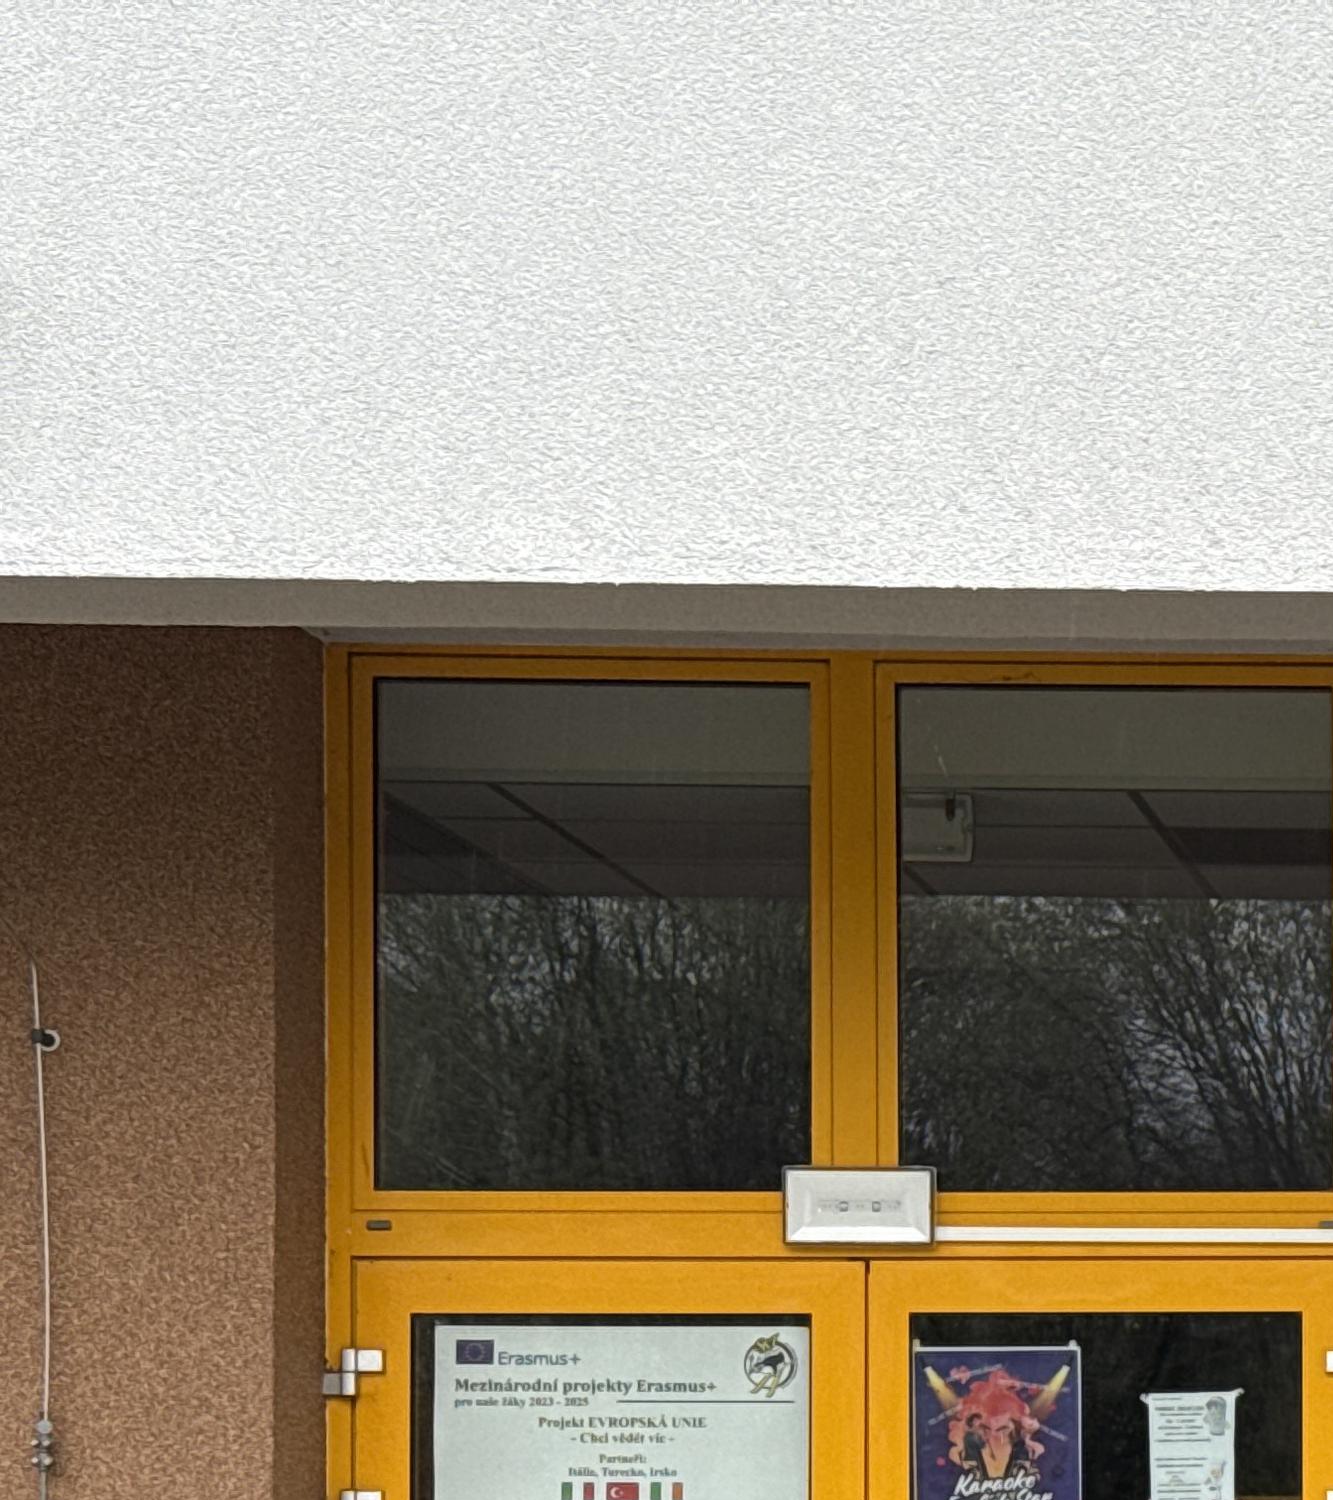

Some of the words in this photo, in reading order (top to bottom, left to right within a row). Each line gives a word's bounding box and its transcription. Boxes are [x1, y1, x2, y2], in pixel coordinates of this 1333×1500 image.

[498, 1352, 581, 1366] Erasmus+
[455, 1378, 558, 1394] Mezinárodní
[563, 1378, 633, 1397] projekty
[637, 1379, 717, 1394] Erasmus+
[538, 1417, 585, 1431] Projekt
[589, 1414, 667, 1429] EVROPSKÁ
[672, 1417, 706, 1429] UNIE
[953, 1473, 1037, 1498] Karaoke
